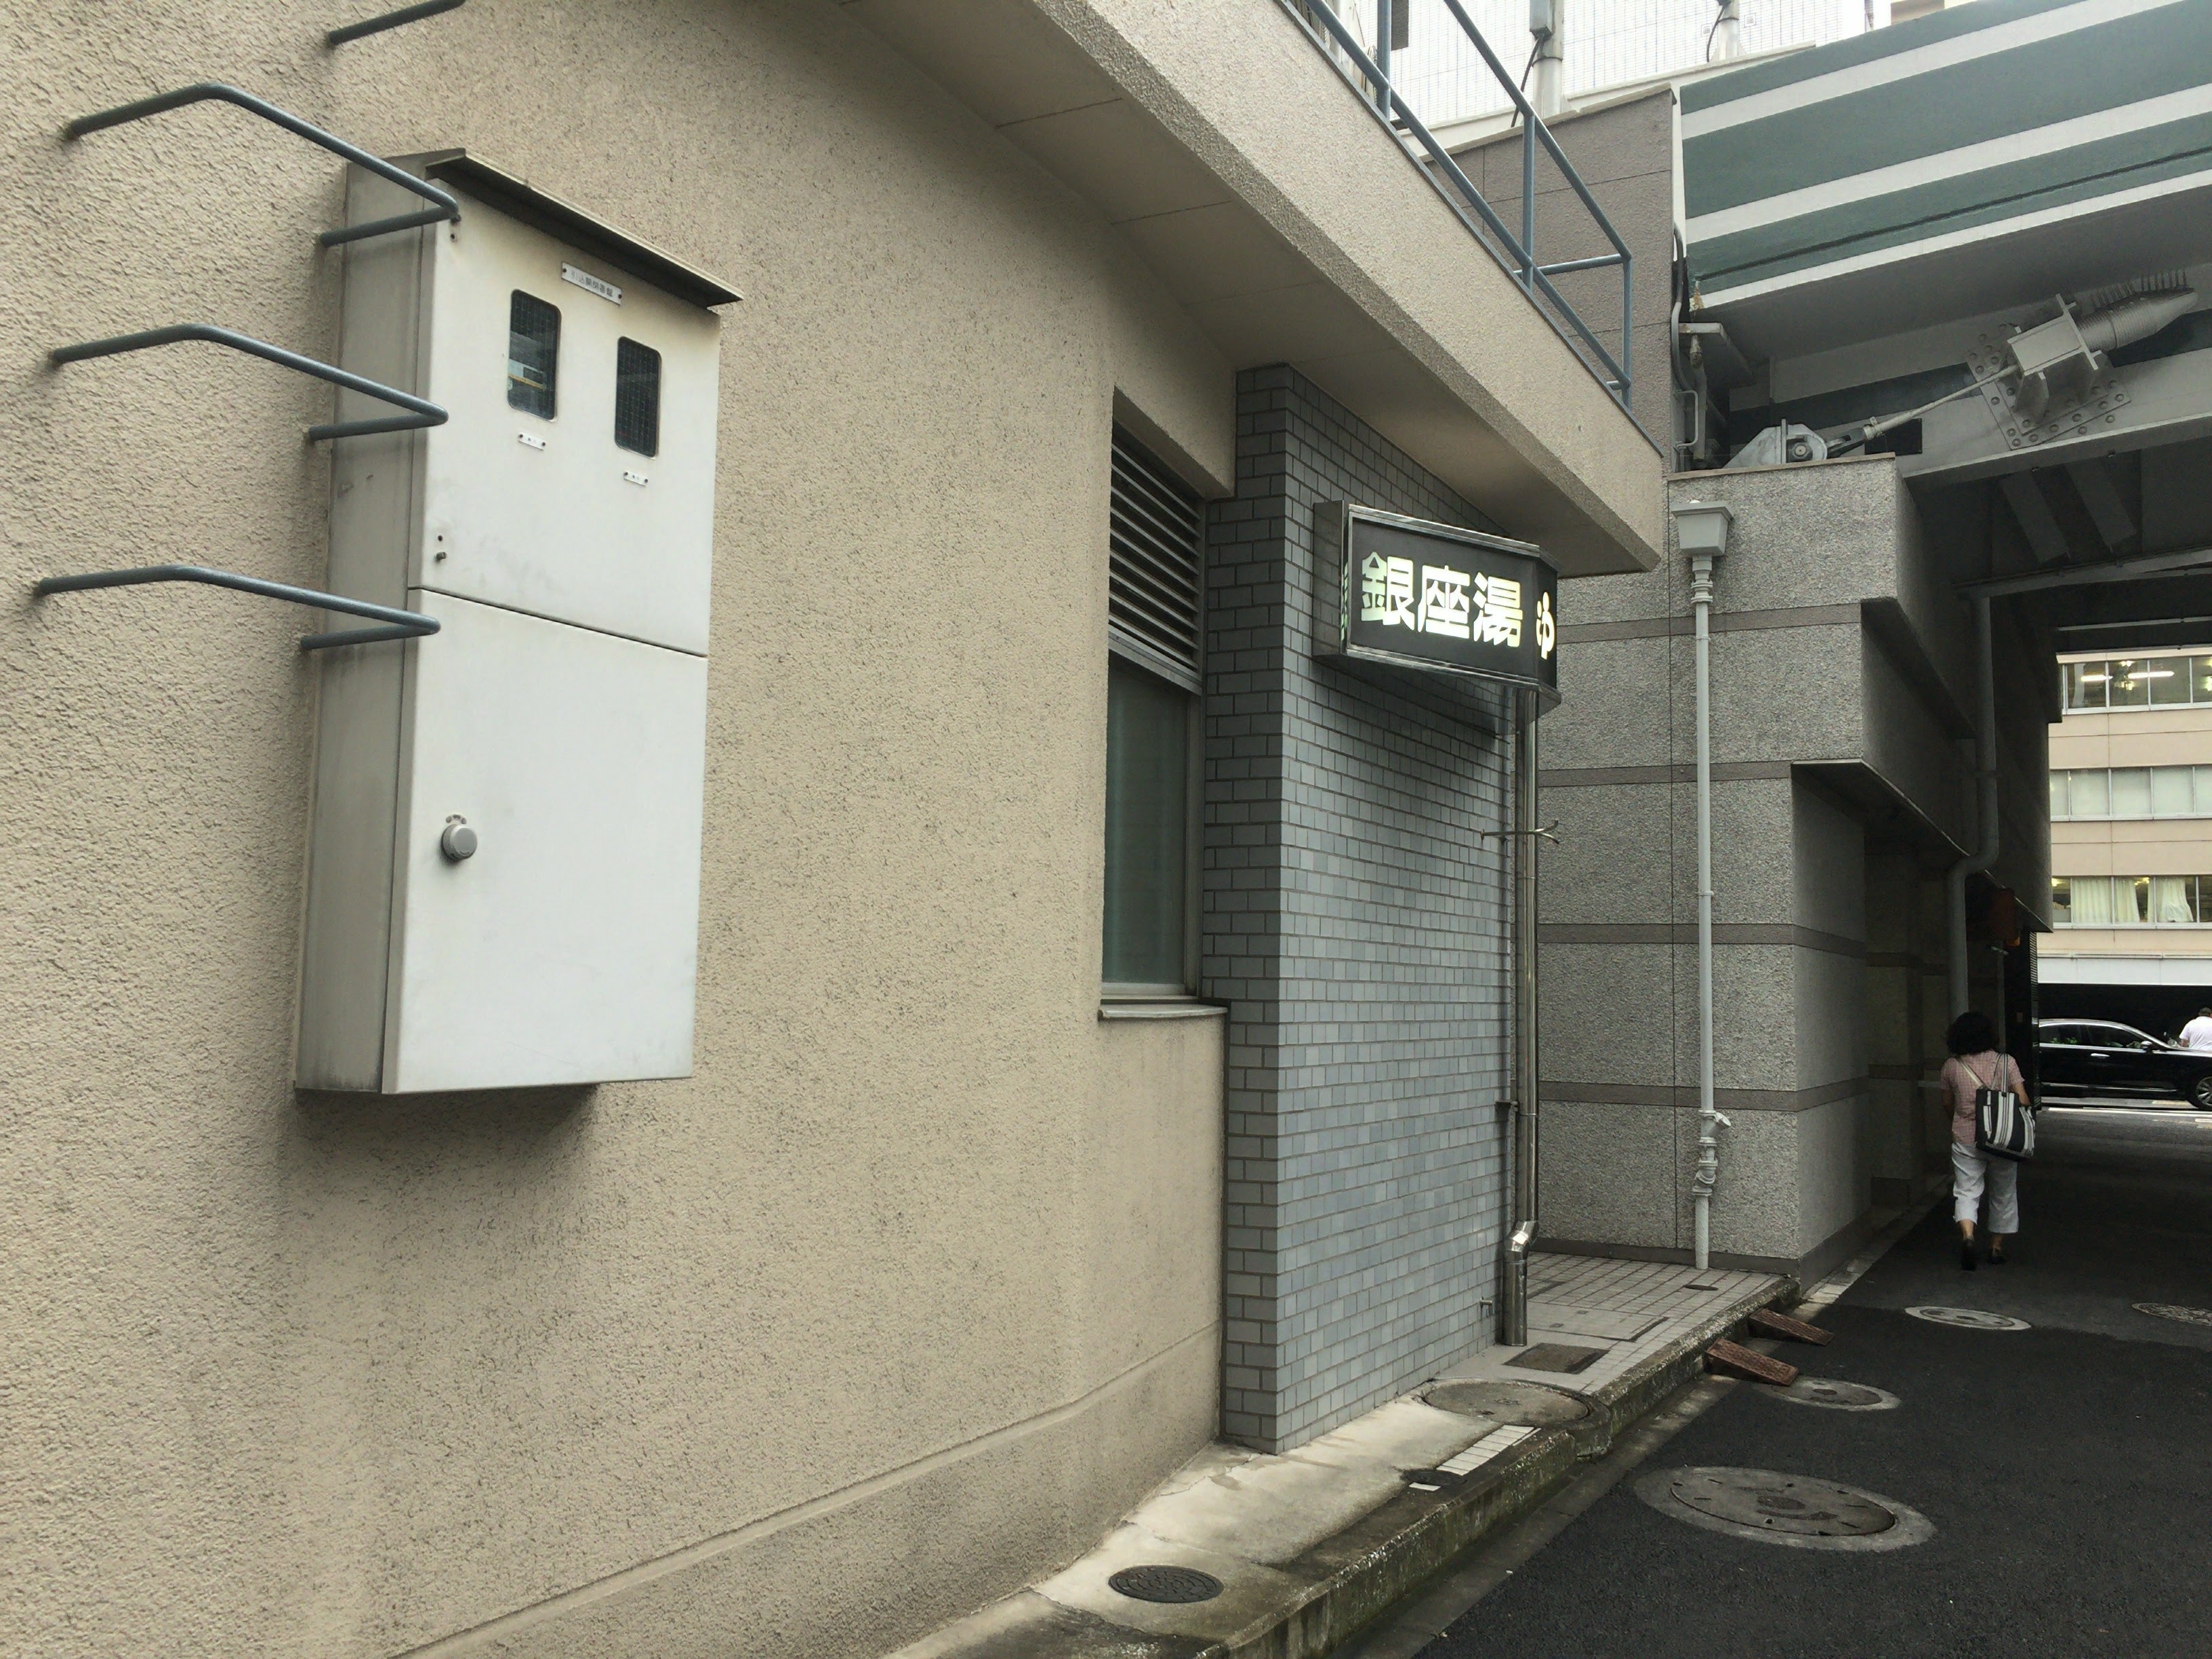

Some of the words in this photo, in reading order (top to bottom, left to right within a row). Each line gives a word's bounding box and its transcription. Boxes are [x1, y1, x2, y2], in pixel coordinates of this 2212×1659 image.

[1361, 551, 1523, 647] 銀座湯
[1536, 591, 1555, 660] ゆ
